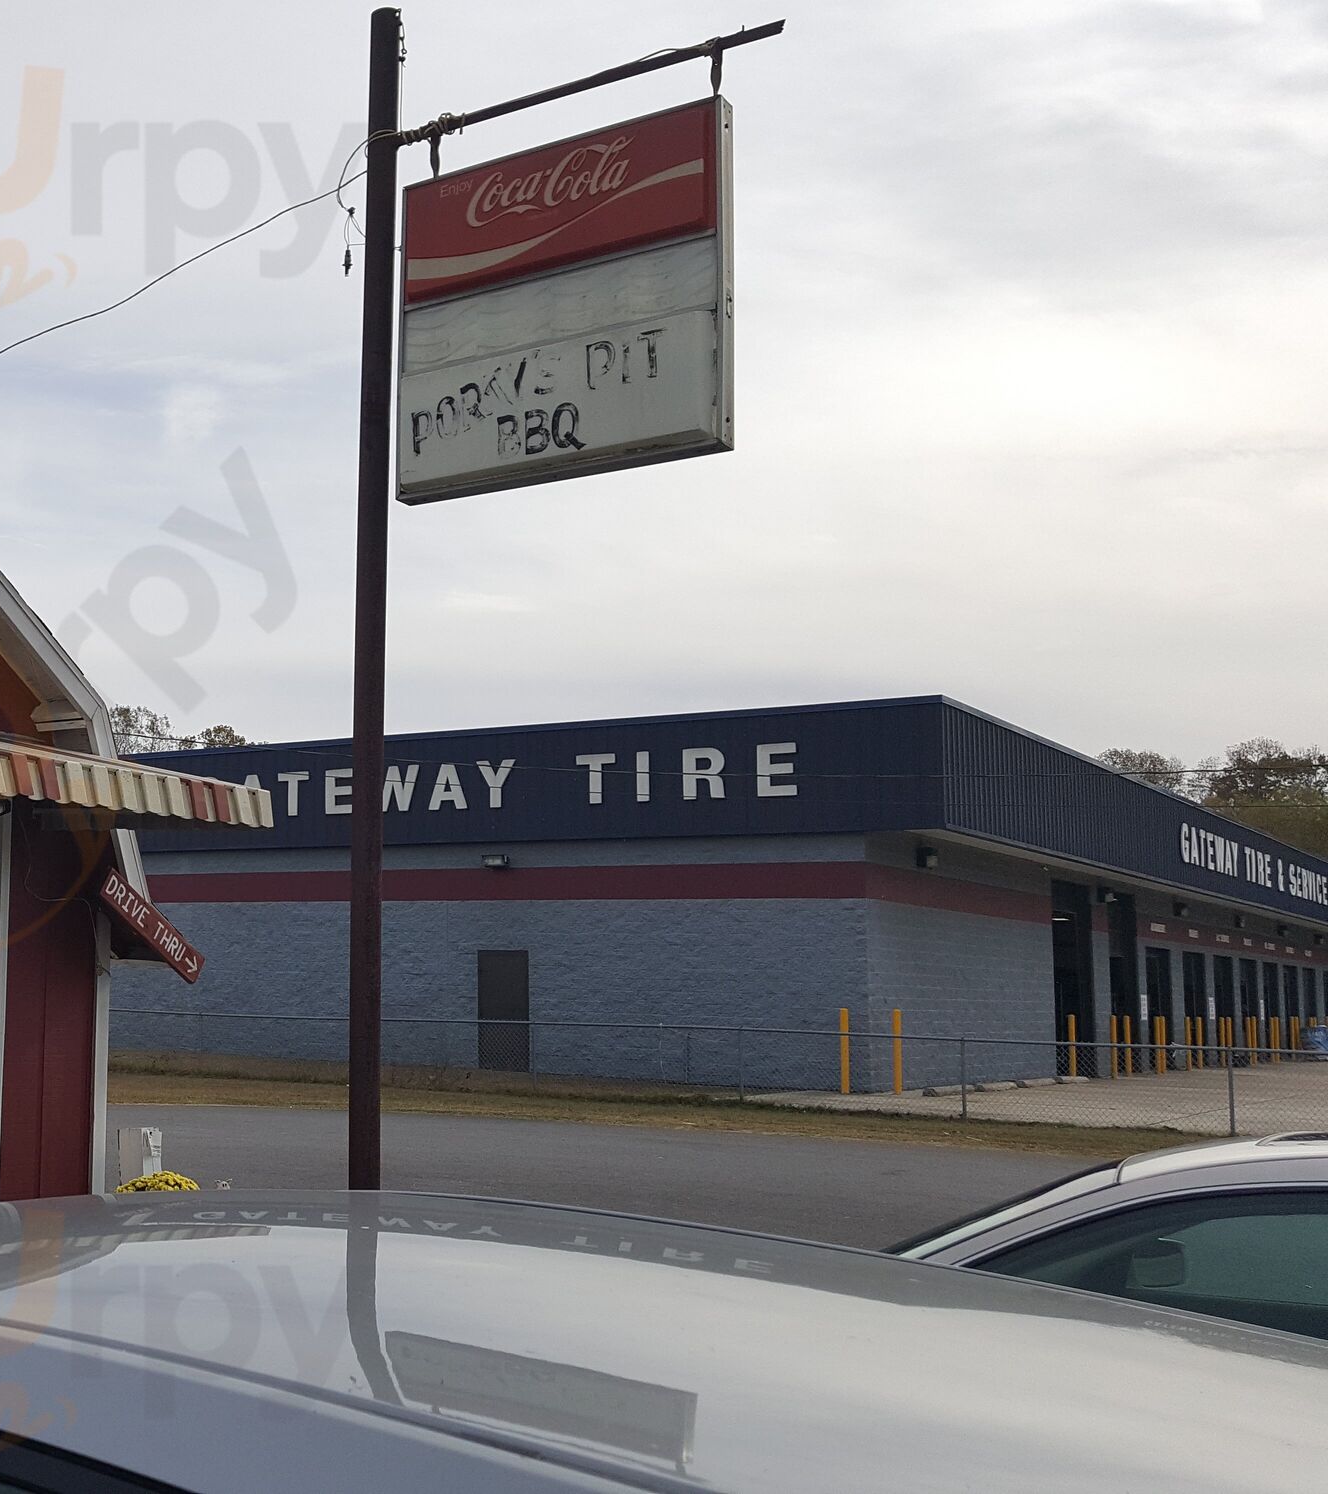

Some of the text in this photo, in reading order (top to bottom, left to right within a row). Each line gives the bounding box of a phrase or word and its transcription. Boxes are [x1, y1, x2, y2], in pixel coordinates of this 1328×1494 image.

[439, 179, 473, 198] Enjoy
[466, 136, 636, 228] Coca-Cola
[586, 328, 668, 390] PIT
[497, 402, 587, 457] BBQ
[576, 742, 798, 804] TIRE
[1180, 822, 1328, 906] GATEWAY TIRE & SERVICE
[105, 874, 187, 962] DRIVE THRU
